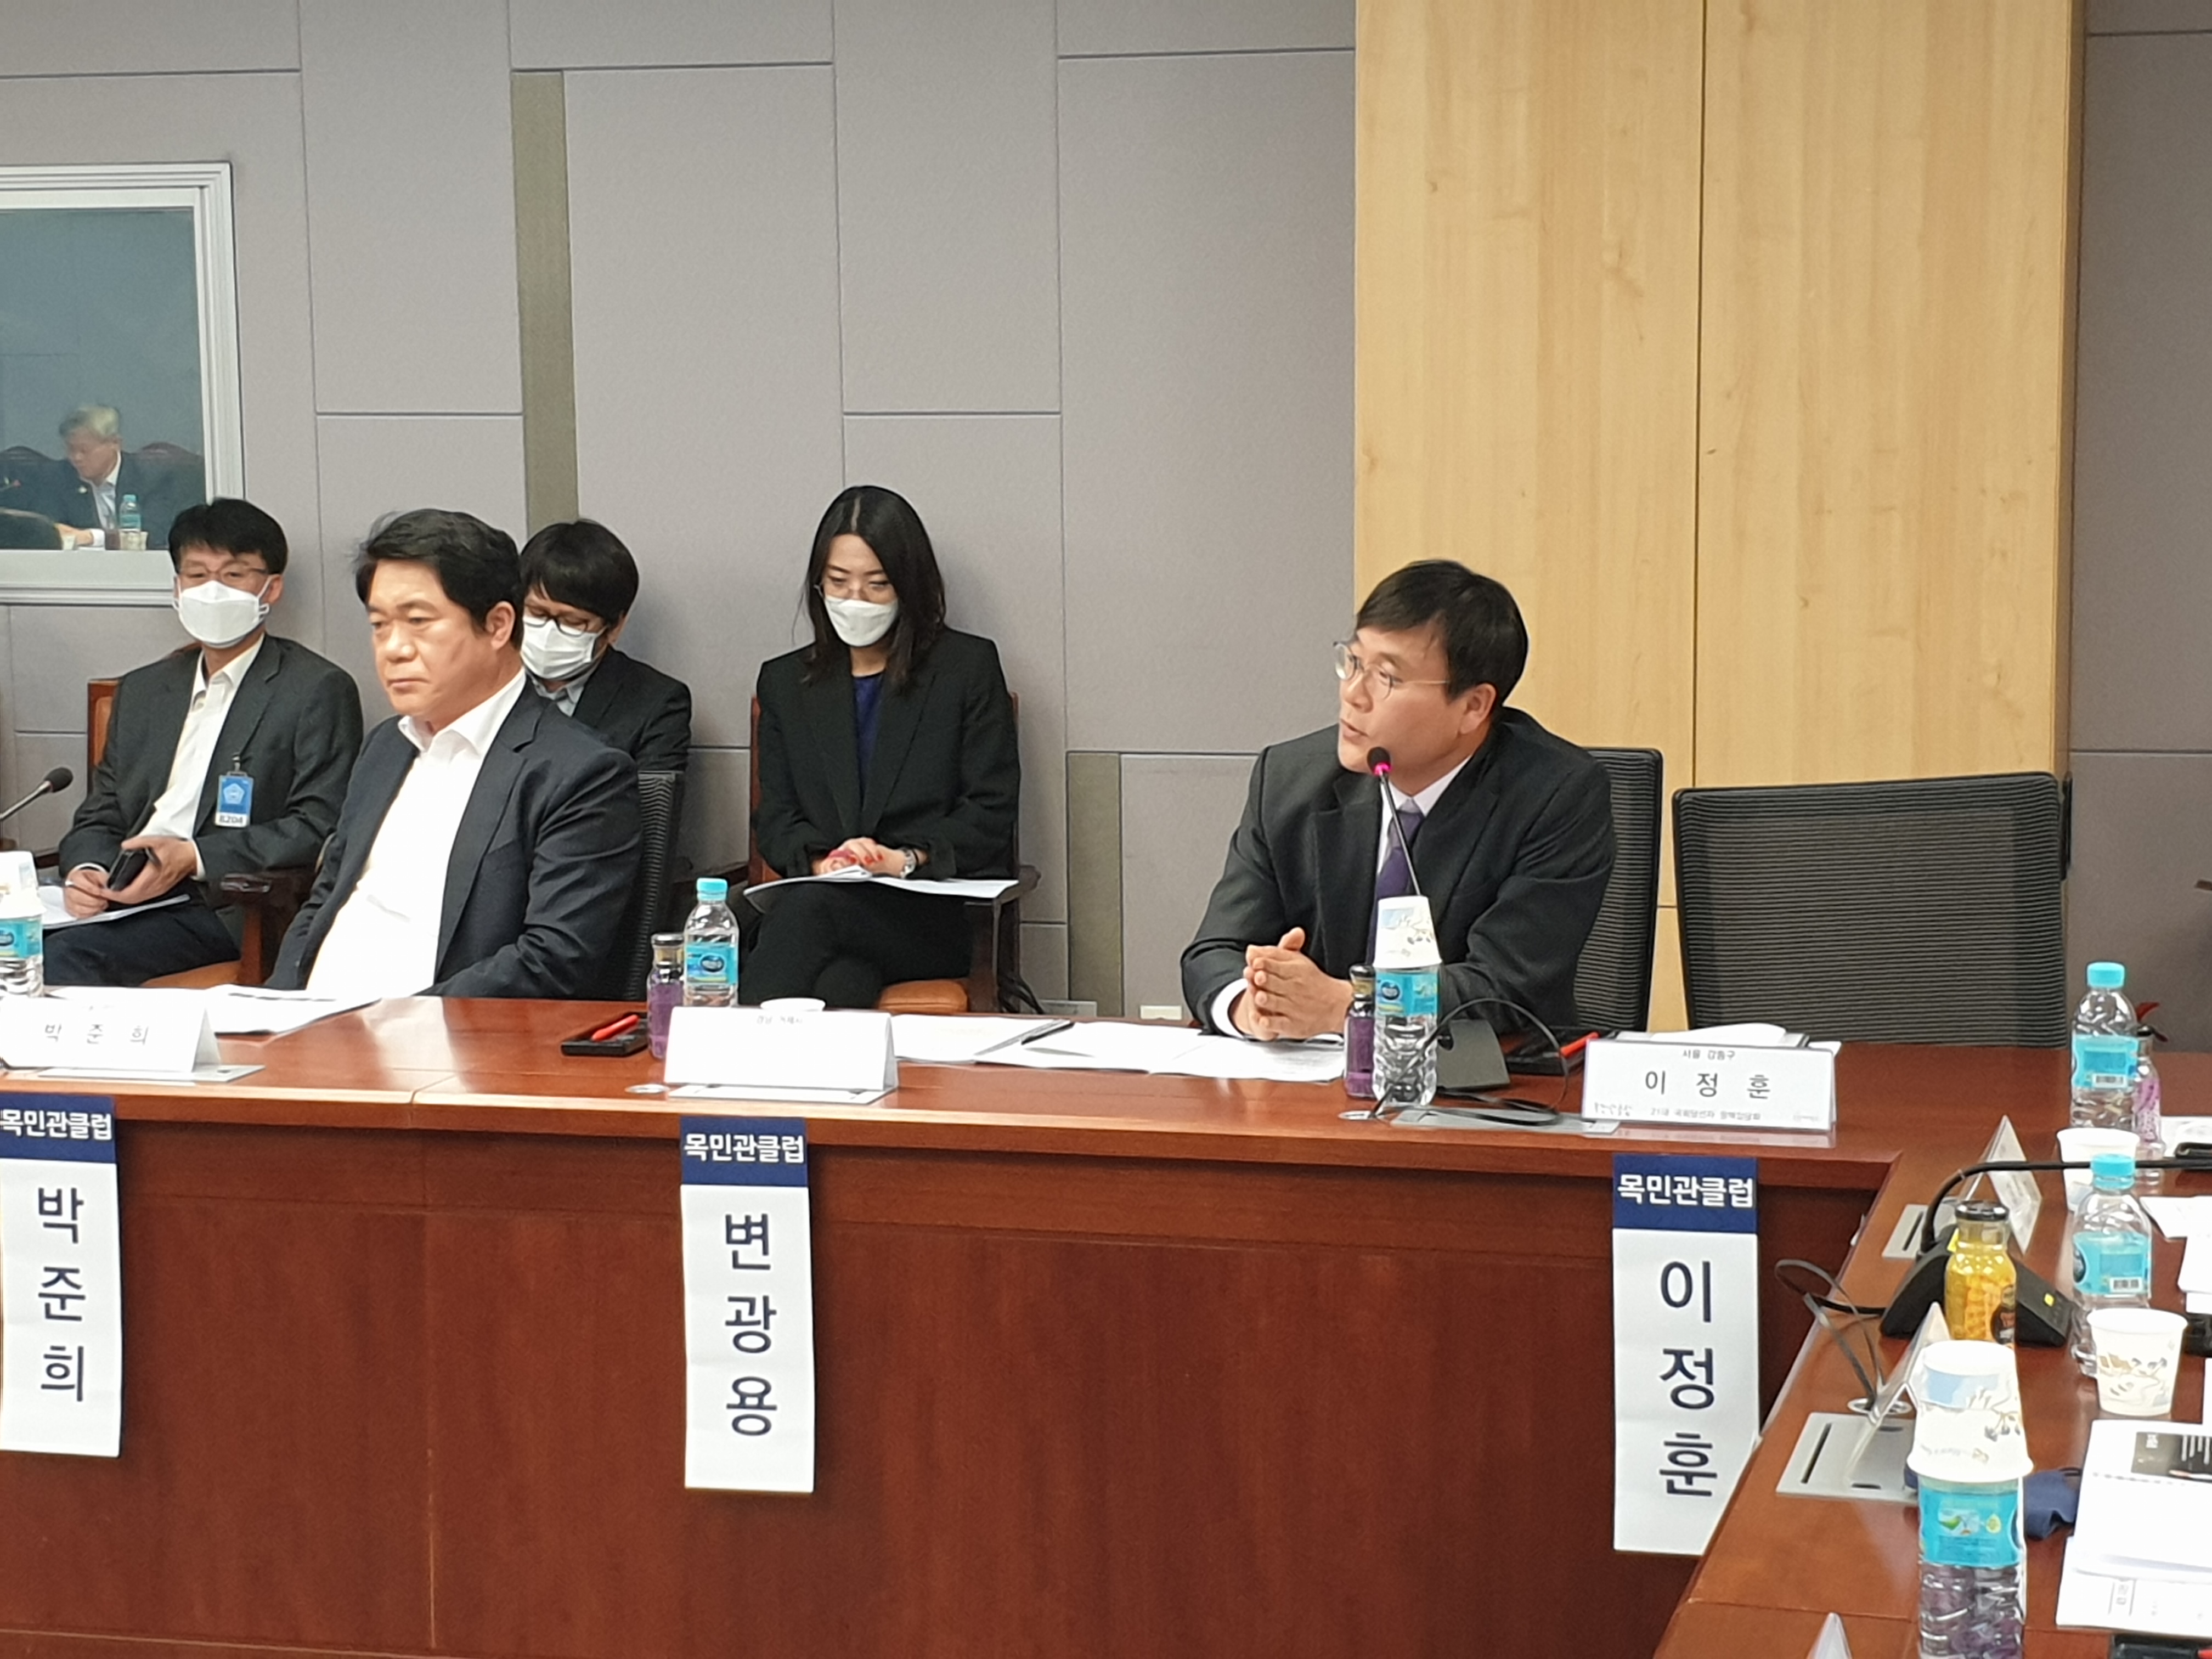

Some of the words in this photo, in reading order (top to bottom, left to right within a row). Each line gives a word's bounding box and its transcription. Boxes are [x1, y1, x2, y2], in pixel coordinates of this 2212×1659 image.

[0, 1109, 112, 1141] 목민관클럽
[684, 1133, 804, 1164] 목민관클럽
[1617, 1173, 1754, 1208] 목민관클럽
